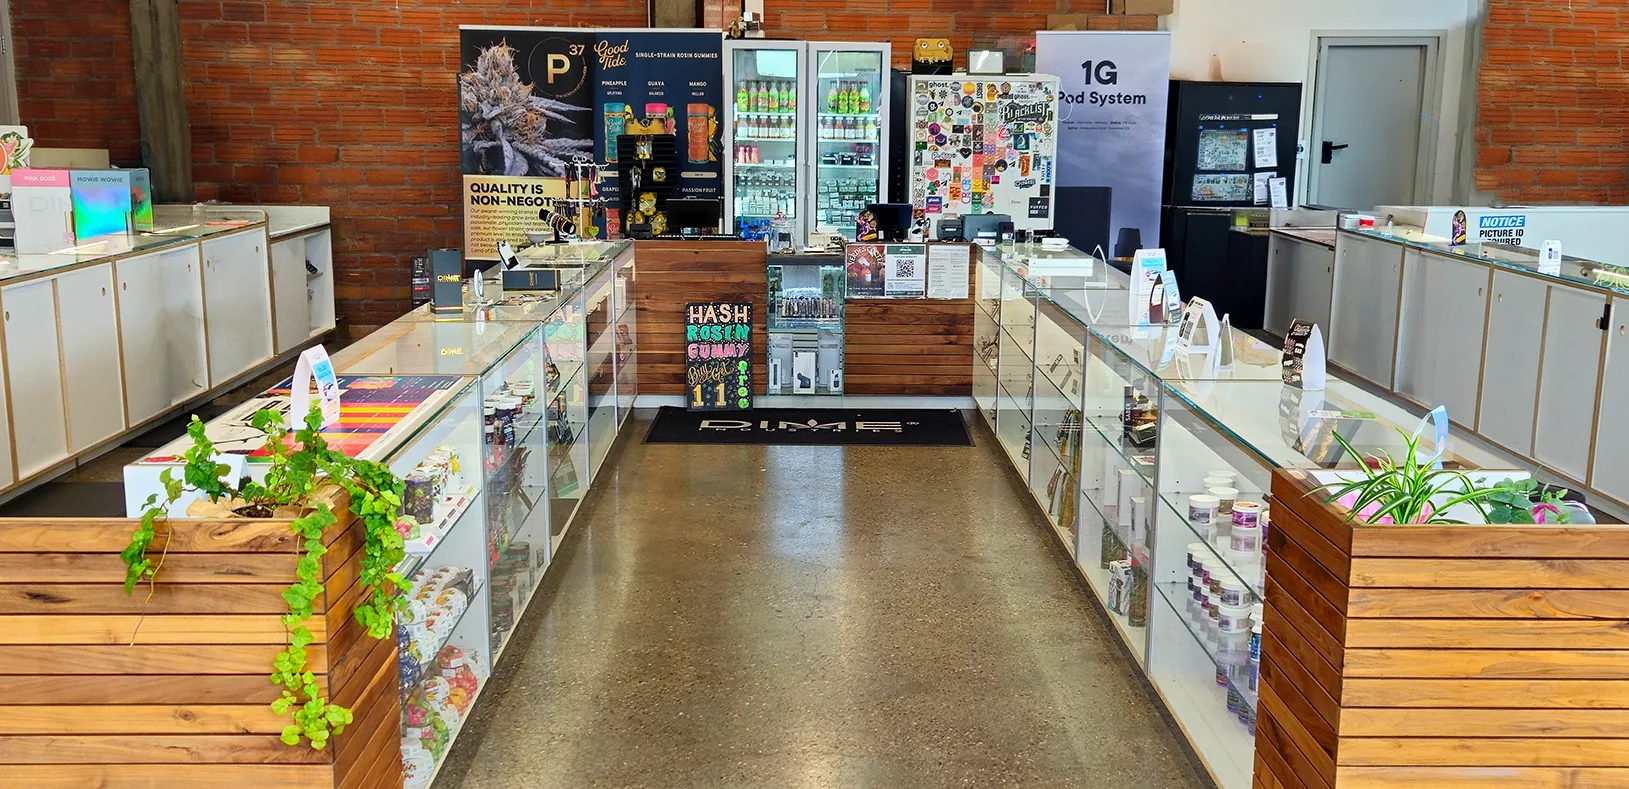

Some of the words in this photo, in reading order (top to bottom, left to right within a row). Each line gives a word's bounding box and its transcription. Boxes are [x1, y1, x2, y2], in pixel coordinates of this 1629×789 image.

[569, 44, 585, 56] 37
[593, 40, 629, 63] Good
[602, 54, 626, 70] Tide
[1081, 60, 1118, 85] 1G
[1058, 91, 1085, 105] Pod
[1089, 91, 1147, 107] System
[470, 183, 528, 194] QUALITY
[531, 184, 543, 194] IS
[1482, 216, 1524, 227] NOTICE
[1480, 229, 1513, 237] PICTURE
[1515, 229, 1524, 237] ID
[689, 303, 748, 324] HASH
[687, 324, 750, 341] ROSIN
[687, 342, 751, 359] GUMMY
[688, 362, 712, 387] Buy
[710, 359, 733, 384] Get
[691, 384, 704, 408] 1
[713, 383, 727, 408] 1
[700, 418, 902, 429] DIME
